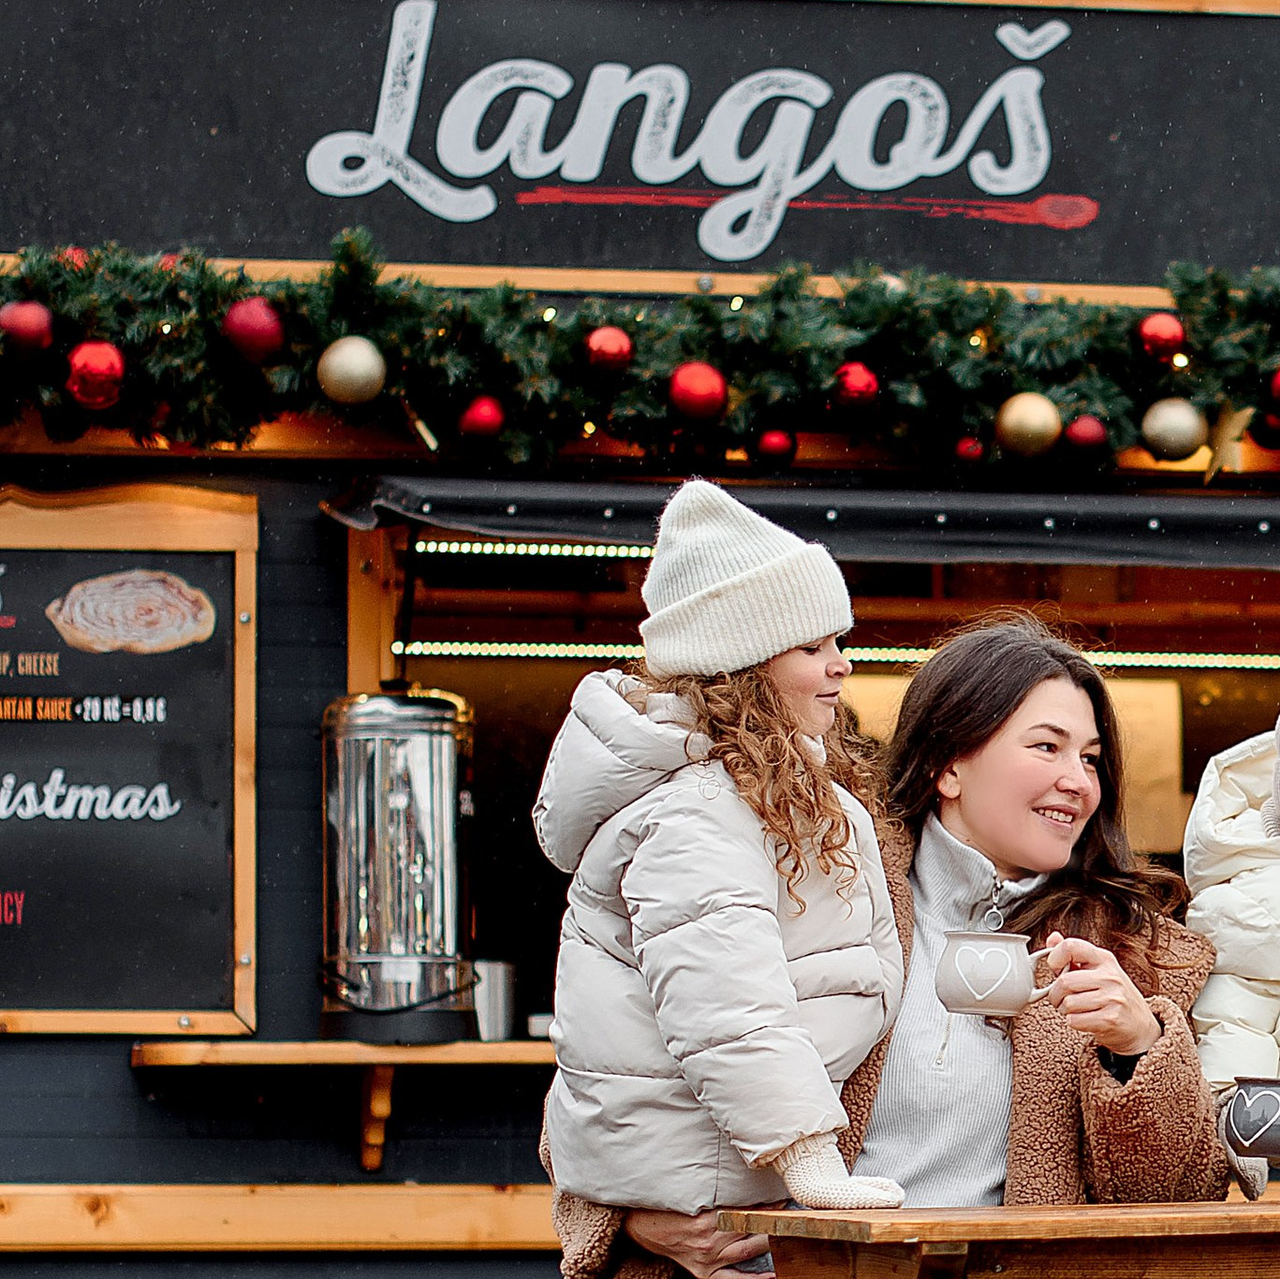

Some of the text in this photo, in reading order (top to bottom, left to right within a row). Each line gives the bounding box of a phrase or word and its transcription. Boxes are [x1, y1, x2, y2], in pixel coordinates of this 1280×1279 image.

[0, 652, 60, 678] P, CHEESE
[36, 697, 73, 721] SAUCE
